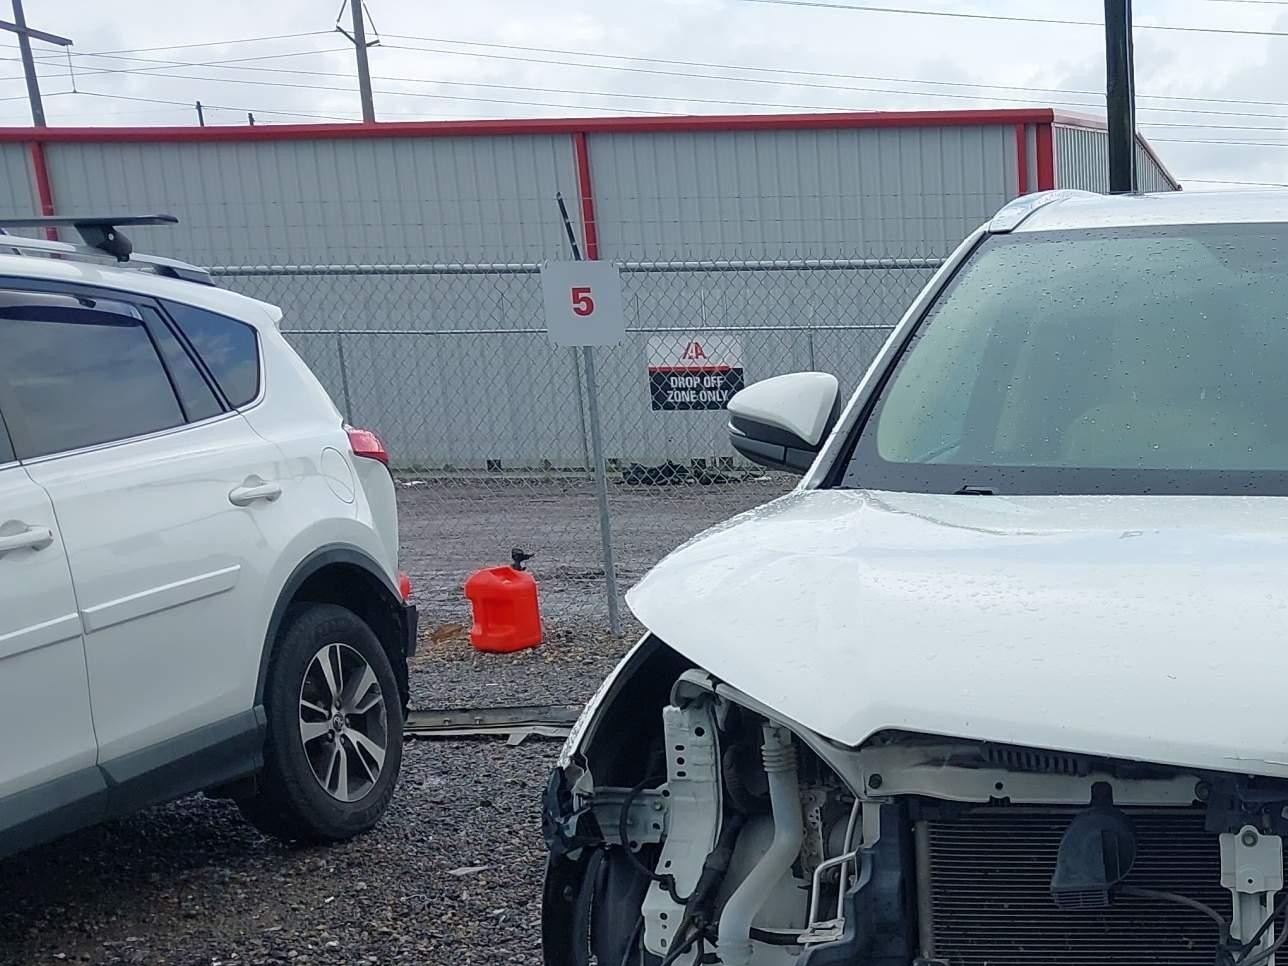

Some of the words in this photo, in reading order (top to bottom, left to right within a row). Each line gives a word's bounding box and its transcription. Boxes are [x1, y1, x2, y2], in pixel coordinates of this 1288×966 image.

[571, 287, 594, 316] 5
[670, 376, 701, 388] DROP
[703, 375, 724, 388] OFF
[666, 390, 697, 402] ZONE
[699, 390, 729, 402] ONLY
